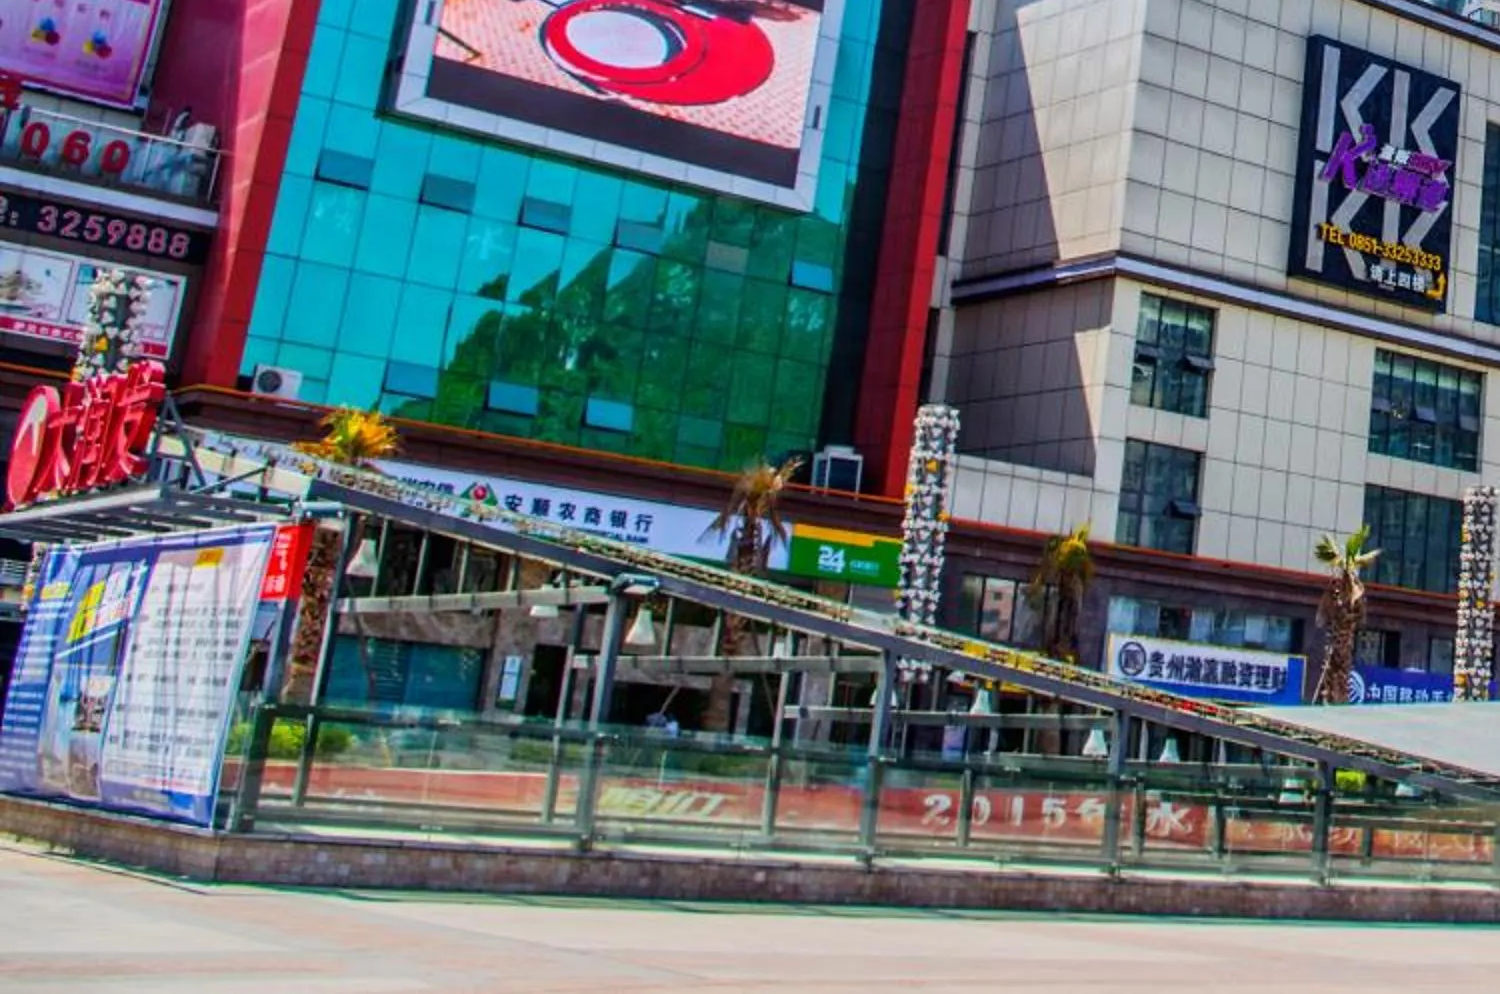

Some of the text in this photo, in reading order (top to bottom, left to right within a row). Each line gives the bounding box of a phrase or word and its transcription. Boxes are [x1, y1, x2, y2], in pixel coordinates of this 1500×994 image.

[37, 205, 190, 258] 3259888
[1318, 222, 1345, 246] TEL
[504, 493, 654, 534] 安顺农商银行
[818, 544, 846, 574] 24
